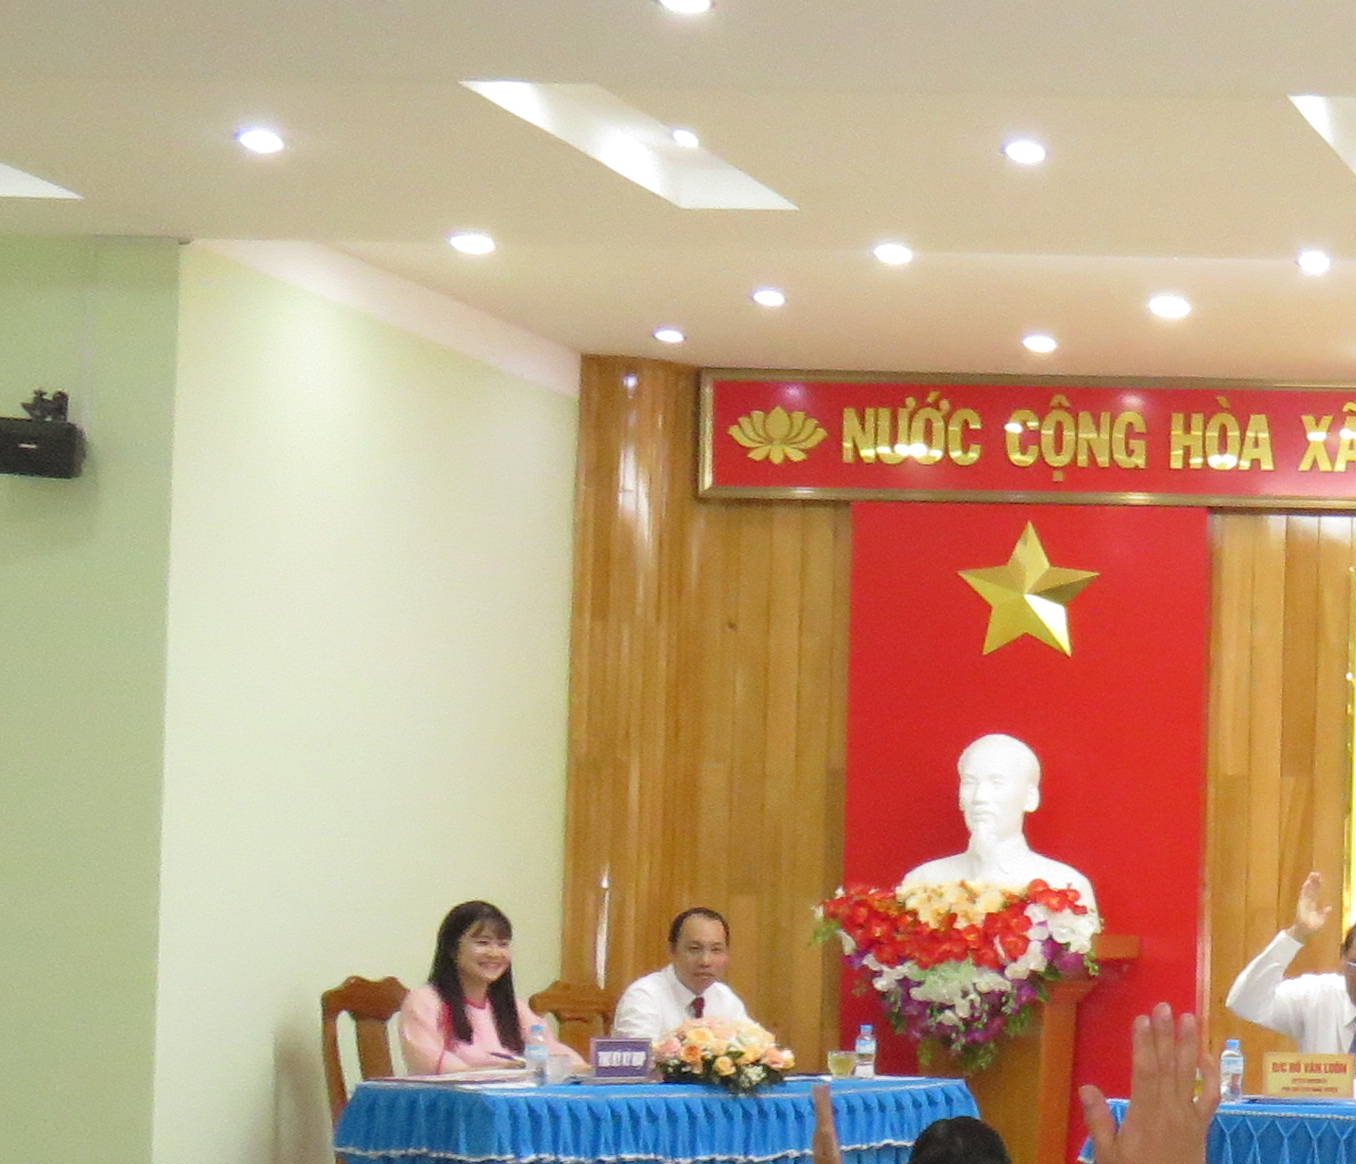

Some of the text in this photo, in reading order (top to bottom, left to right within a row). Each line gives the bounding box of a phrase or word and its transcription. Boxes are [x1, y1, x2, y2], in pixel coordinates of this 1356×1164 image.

[842, 391, 982, 467] NƯỚC
[1004, 394, 1147, 482] CỘNG
[1169, 396, 1274, 470] HÒA
